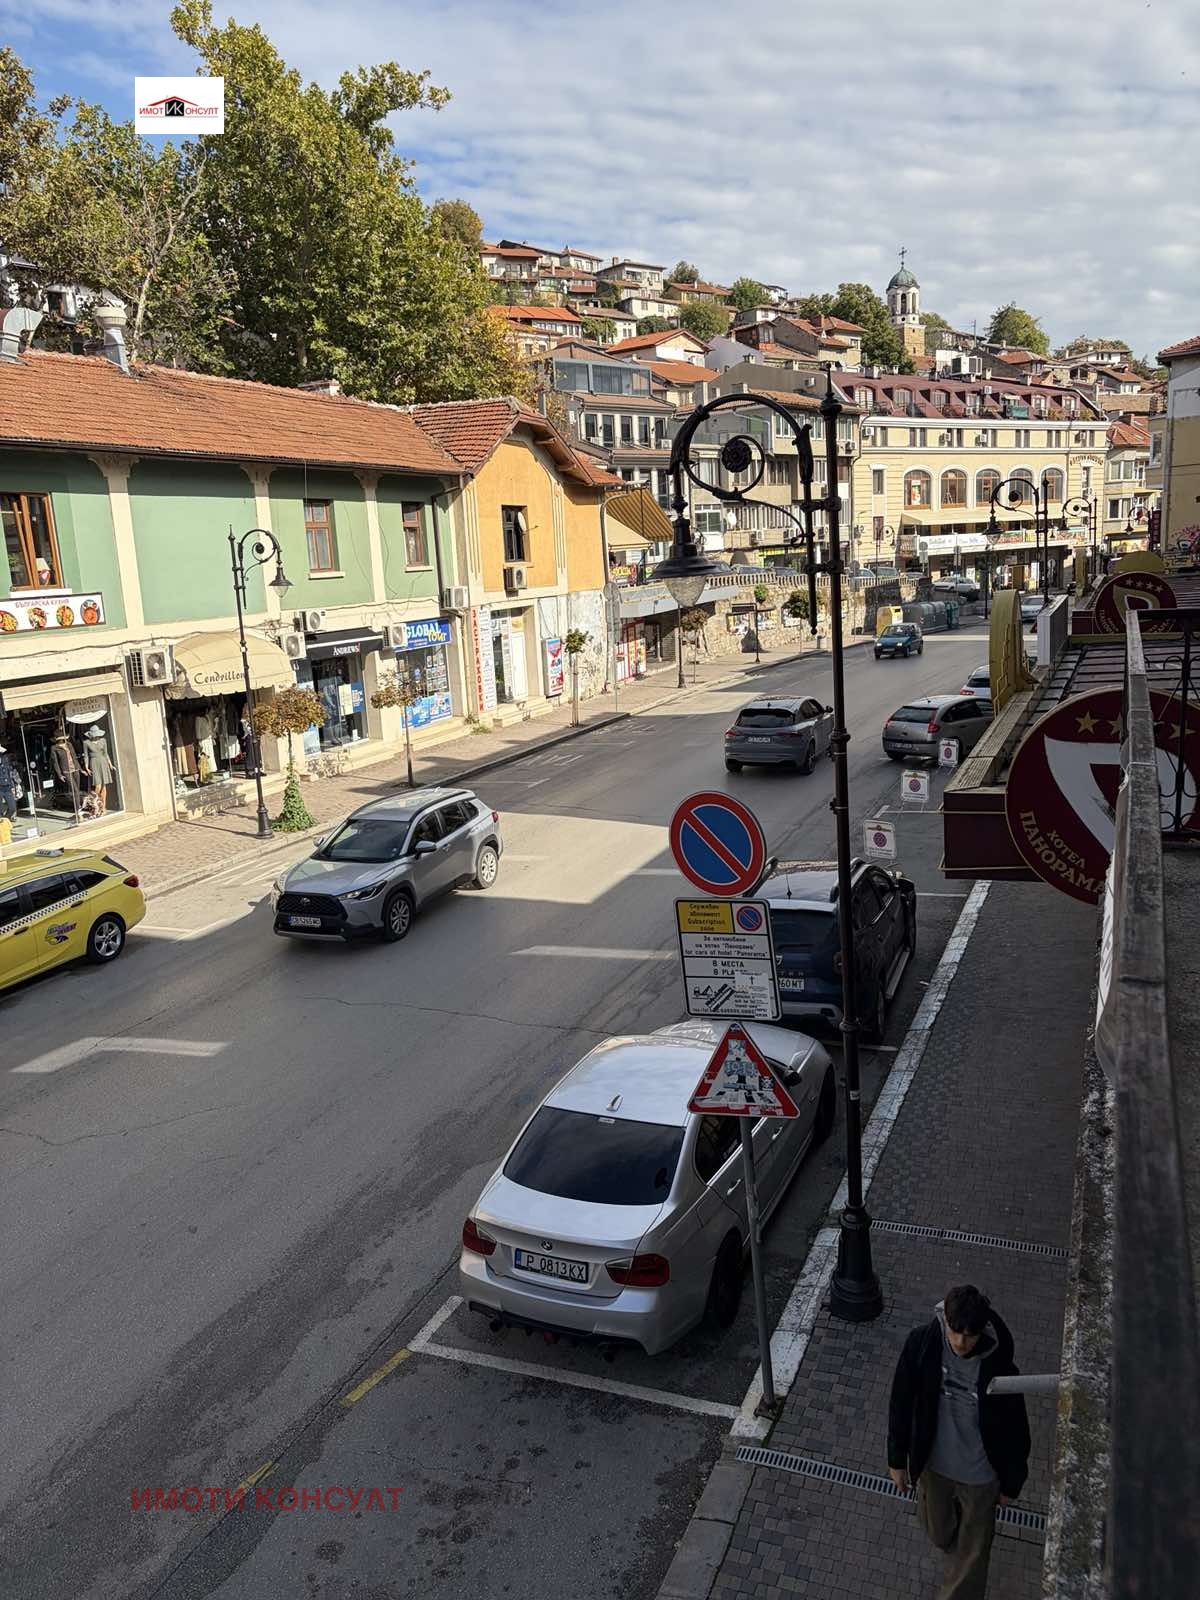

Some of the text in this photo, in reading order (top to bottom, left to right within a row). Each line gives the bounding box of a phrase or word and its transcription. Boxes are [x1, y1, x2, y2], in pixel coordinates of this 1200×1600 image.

[406, 622, 442, 639] GLOBAL
[1046, 829, 1086, 870] ХОТЕЛ
[526, 1254, 535, 1267] P
